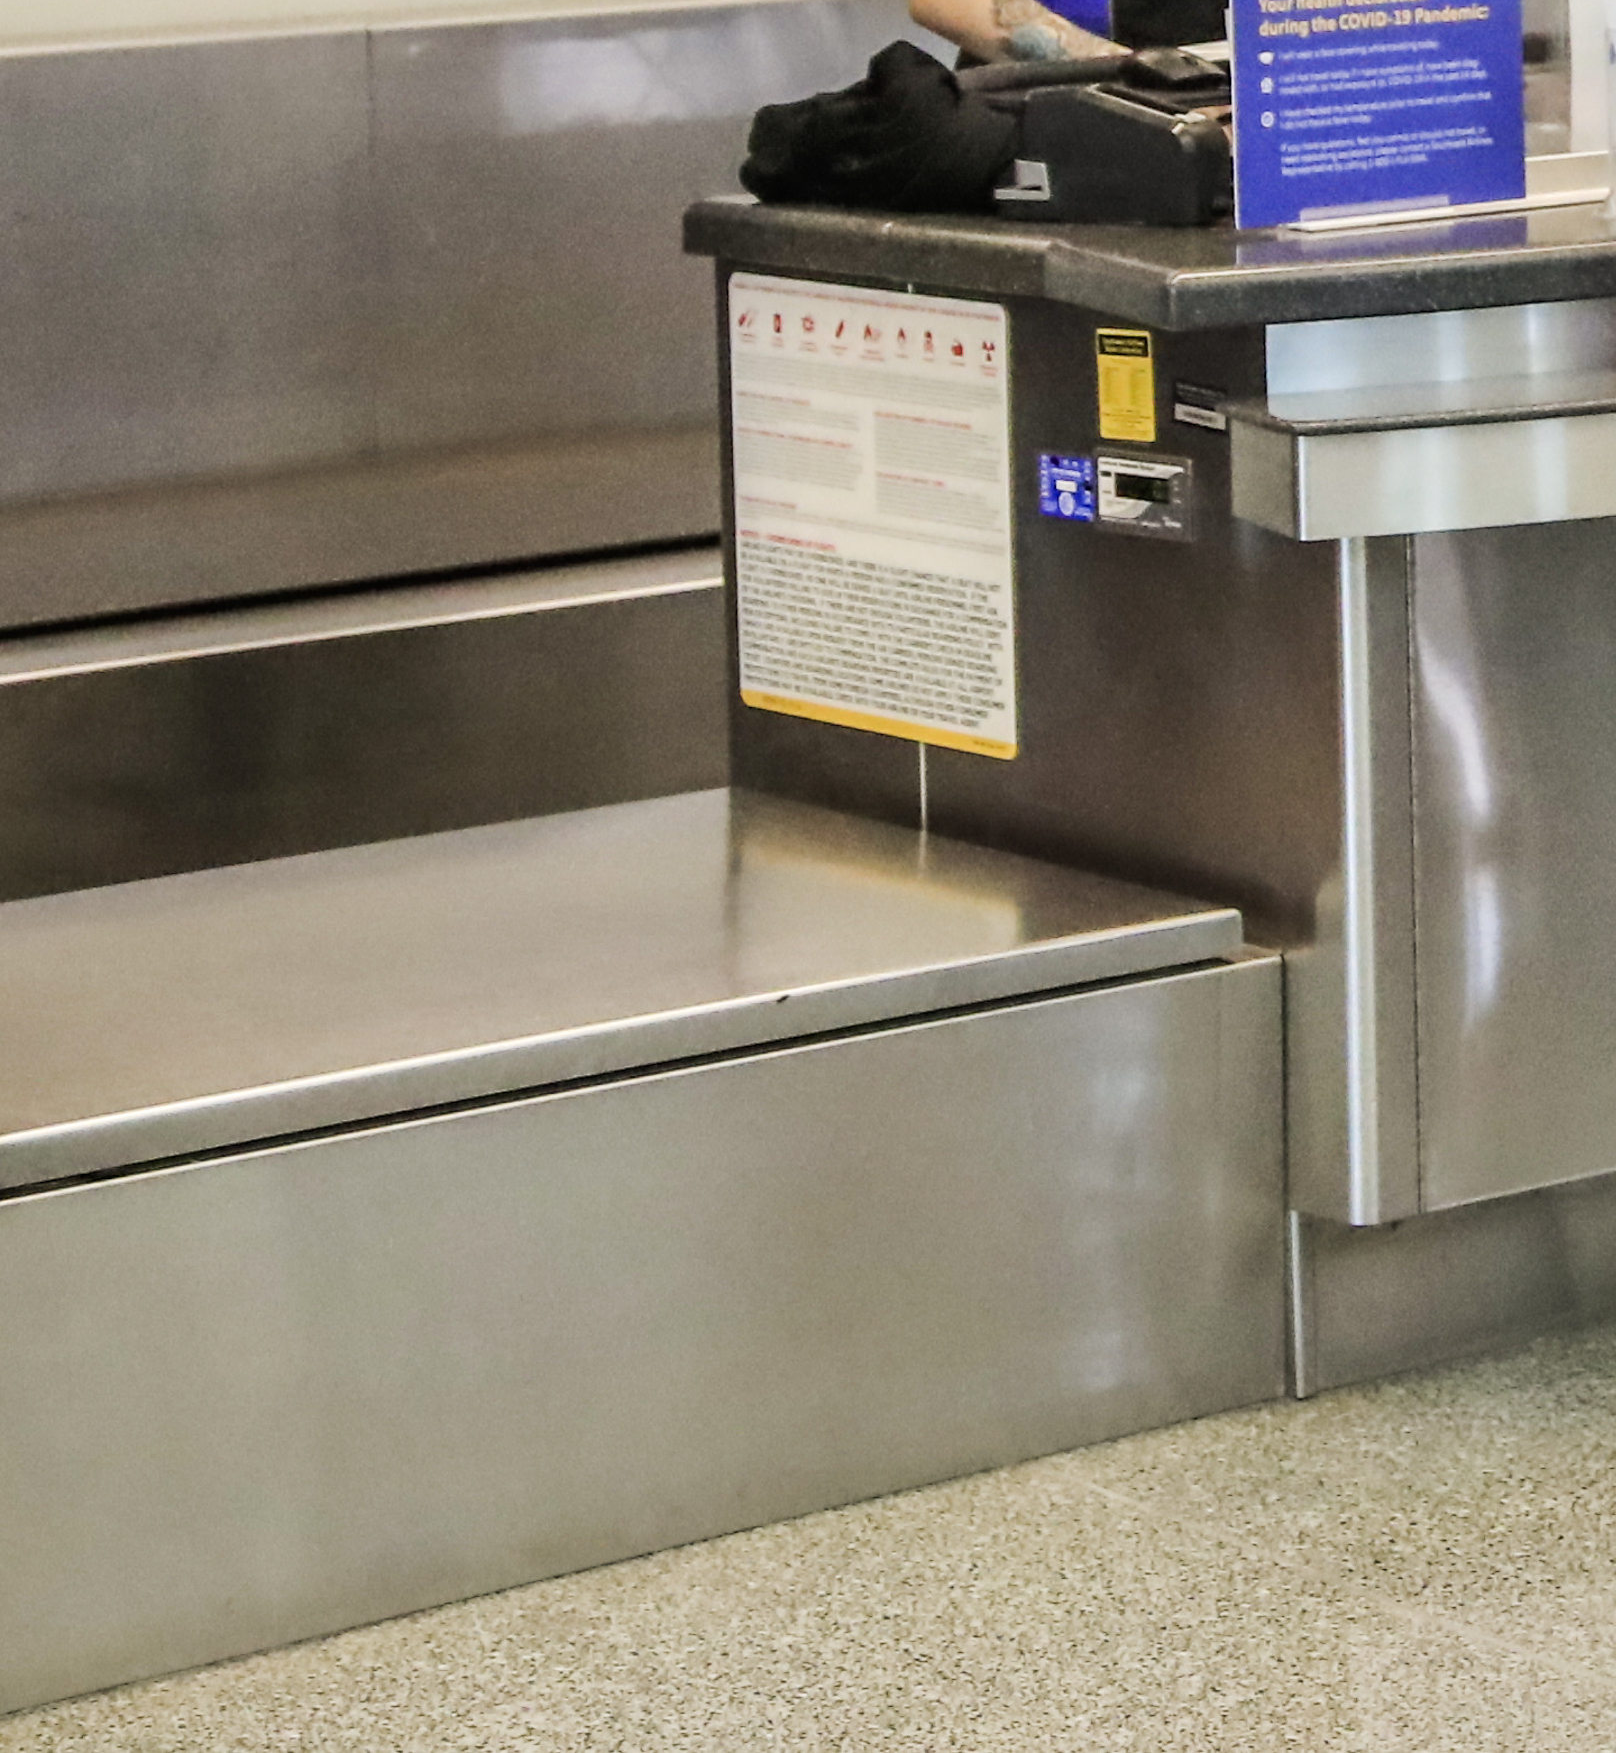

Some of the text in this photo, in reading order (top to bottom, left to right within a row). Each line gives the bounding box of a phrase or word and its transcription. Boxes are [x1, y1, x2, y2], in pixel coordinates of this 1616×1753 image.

[1258, 21, 1309, 38] during
[1311, 16, 1338, 33] the
[1339, 9, 1412, 30] COVID-19
